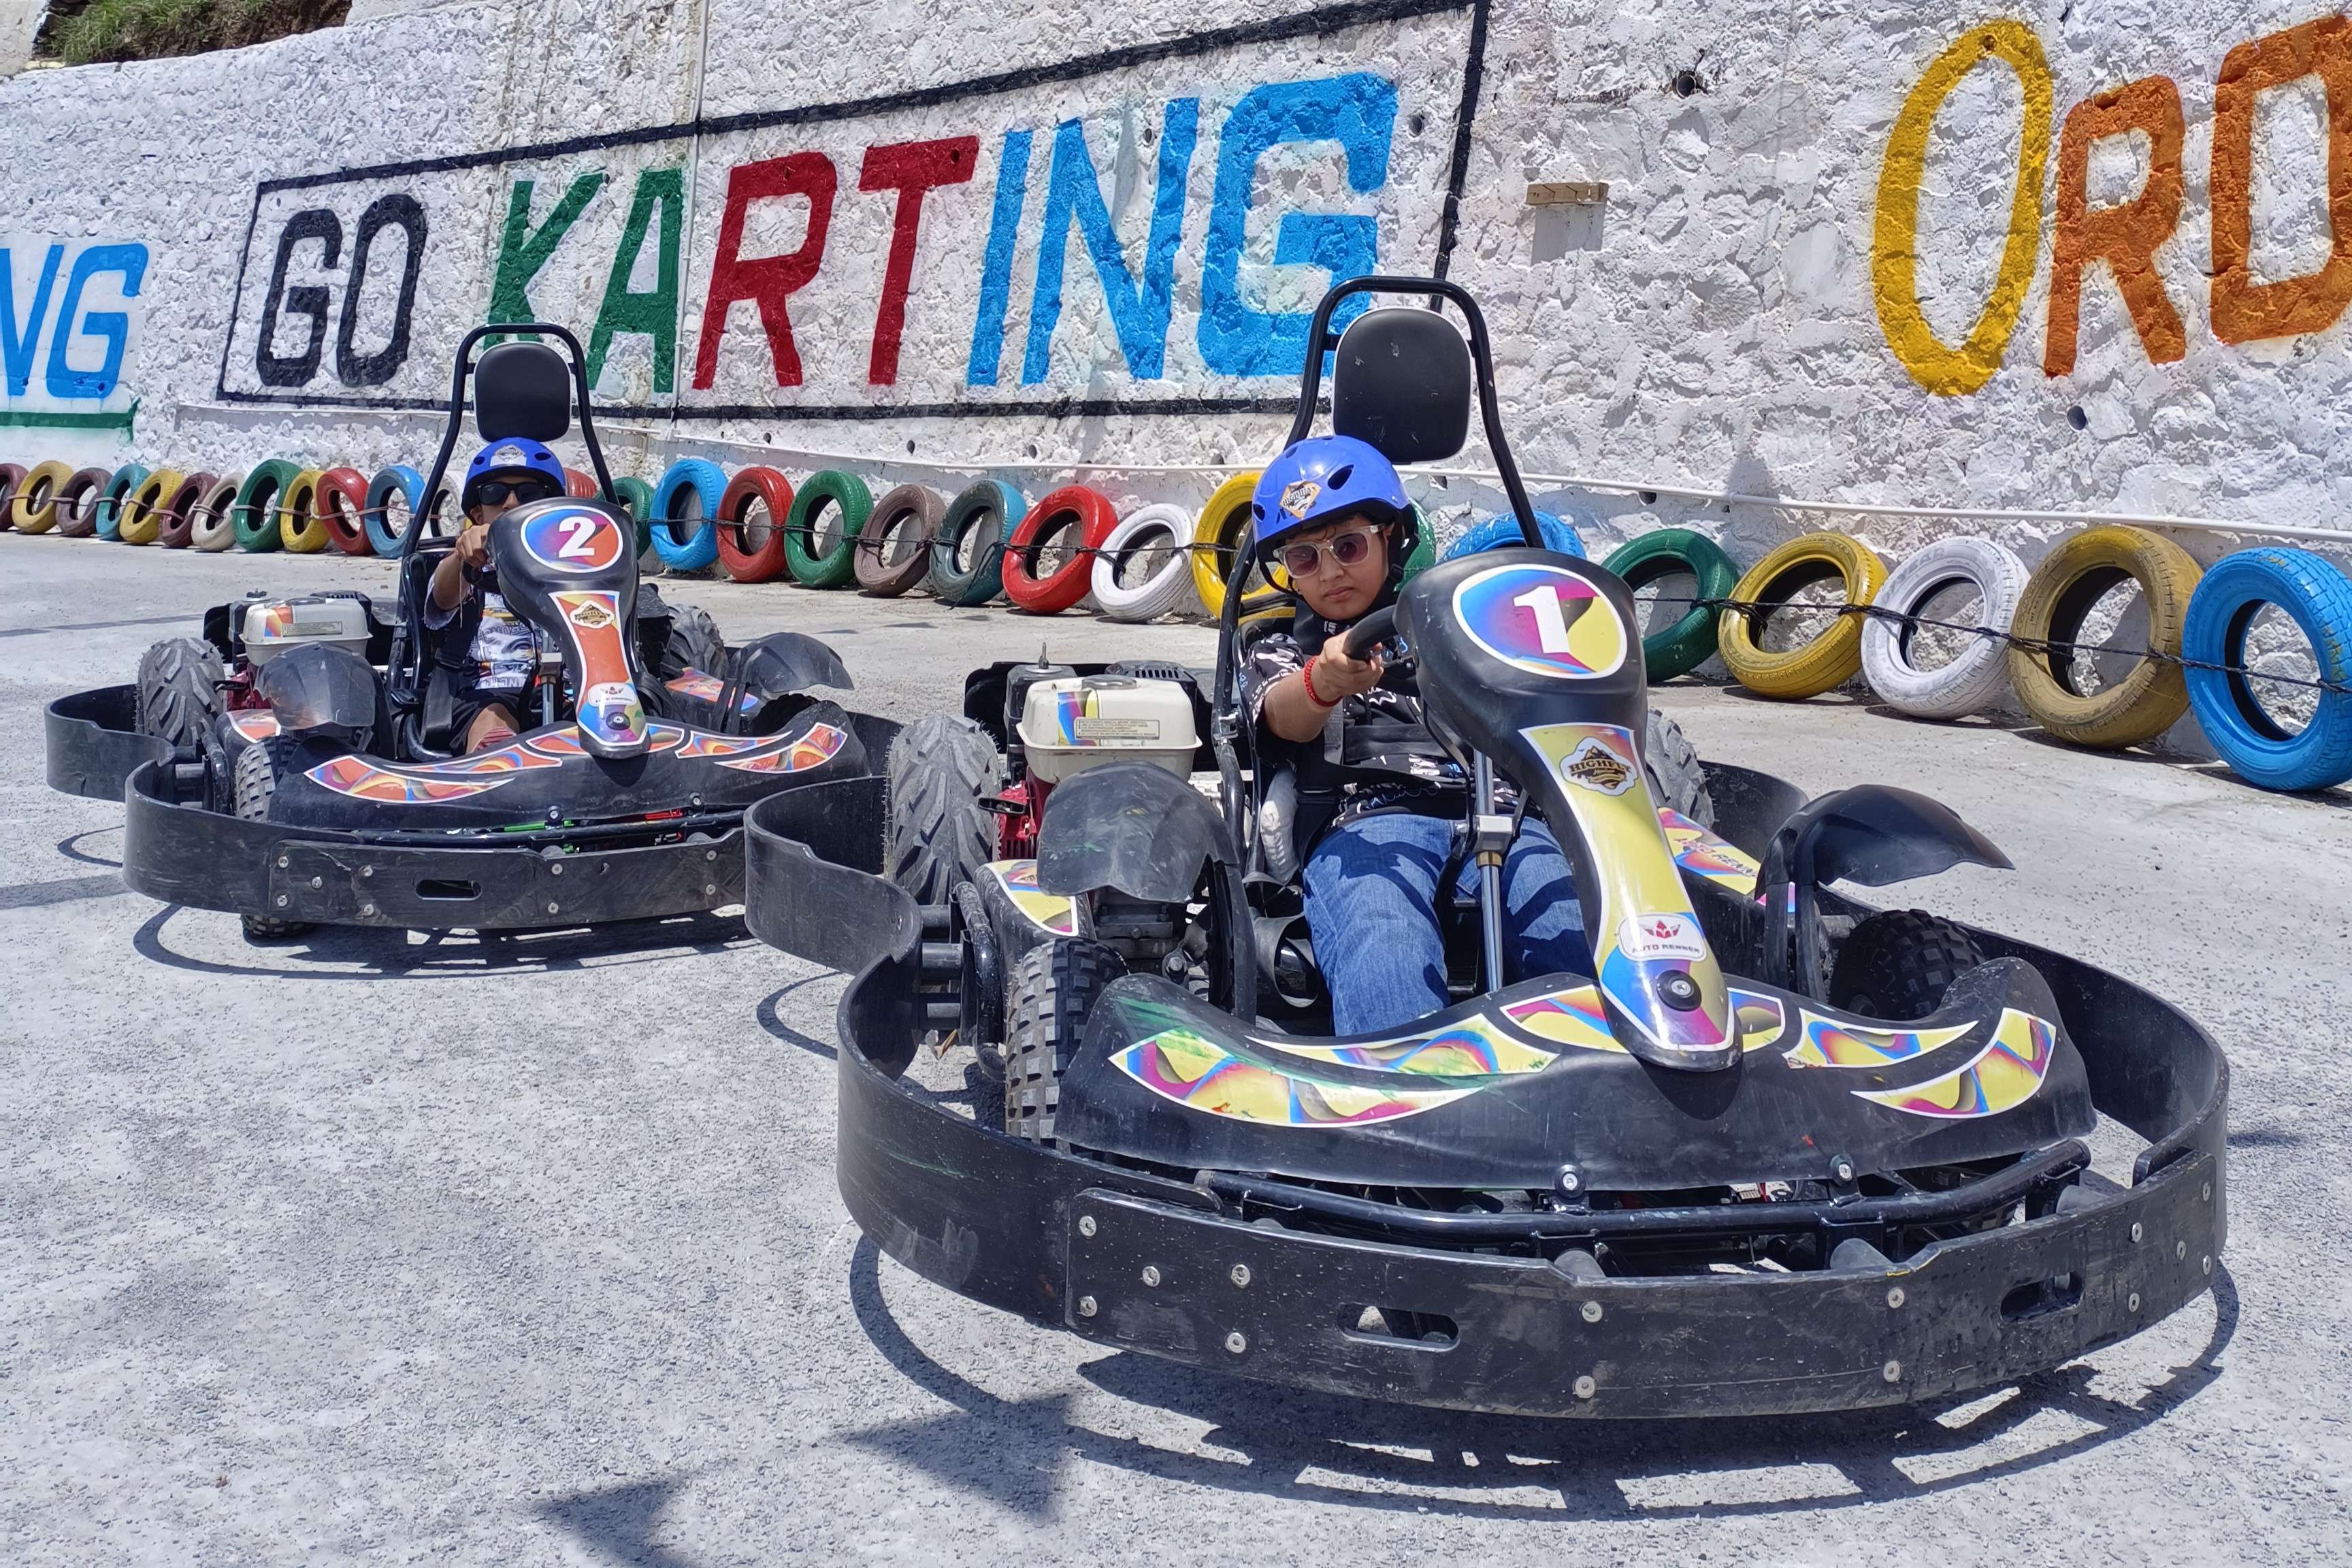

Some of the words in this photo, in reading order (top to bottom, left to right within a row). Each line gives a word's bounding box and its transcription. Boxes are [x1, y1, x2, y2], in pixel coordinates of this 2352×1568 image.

[256, 193, 427, 387] GO
[483, 71, 1399, 393] KARTING
[558, 516, 596, 558] 2
[1513, 585, 1570, 654] 1
